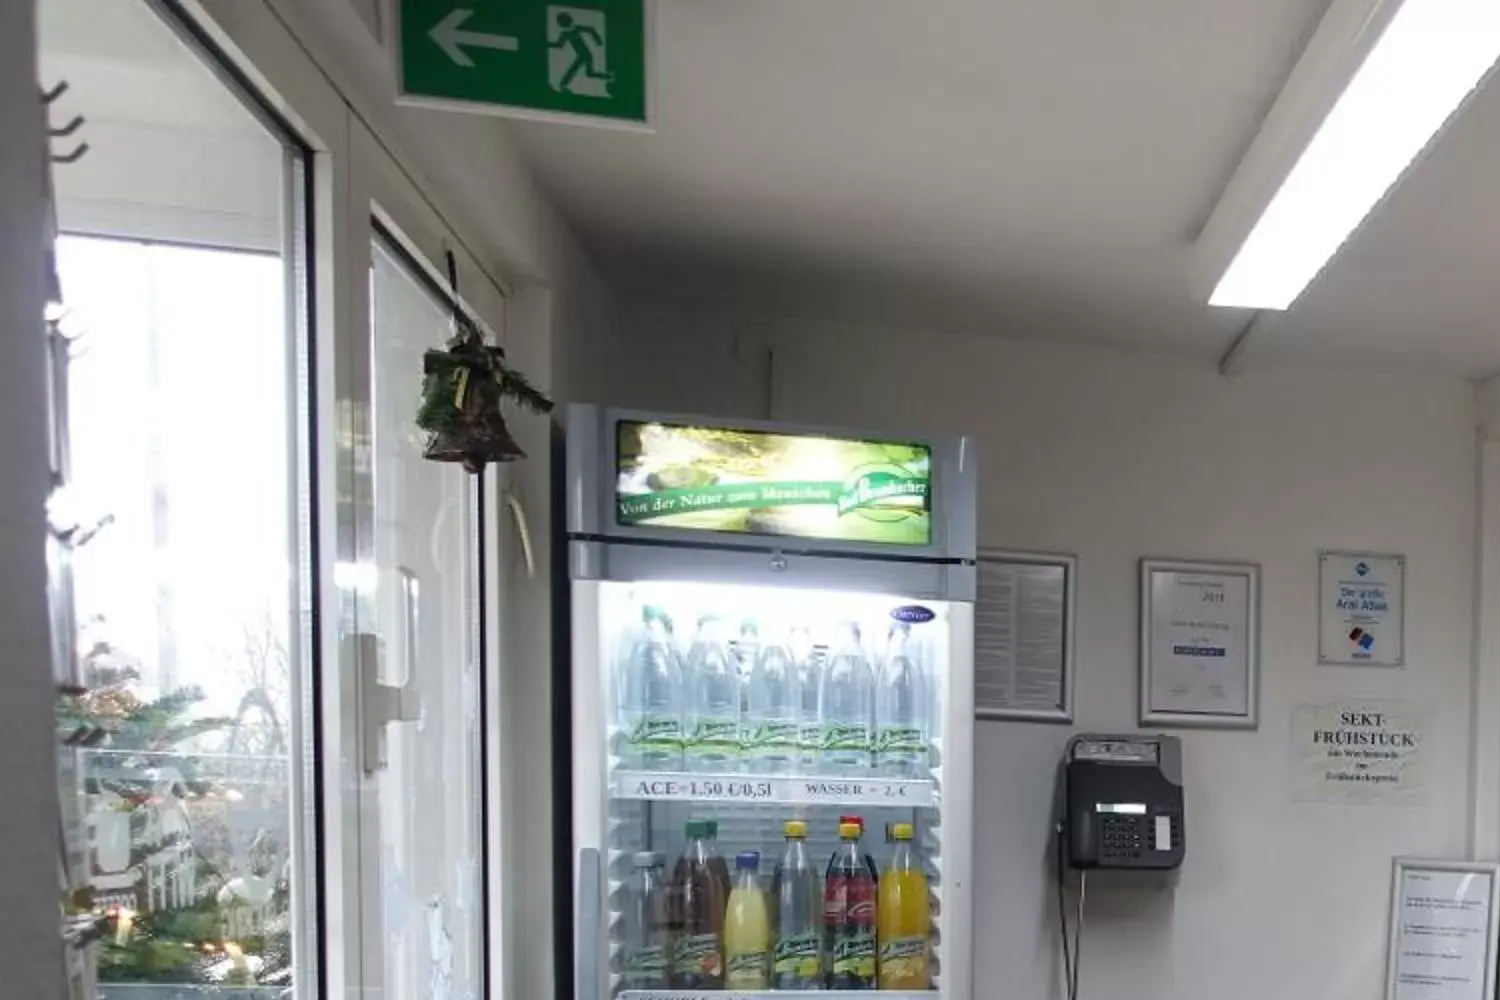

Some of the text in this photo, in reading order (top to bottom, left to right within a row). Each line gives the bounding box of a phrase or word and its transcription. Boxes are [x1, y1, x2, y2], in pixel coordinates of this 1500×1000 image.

[620, 501, 648, 515] Von
[652, 497, 675, 511] der
[680, 493, 722, 507] Natur
[1313, 729, 1415, 747] FRÜHSTÜCK
[805, 783, 863, 796] WASSER
